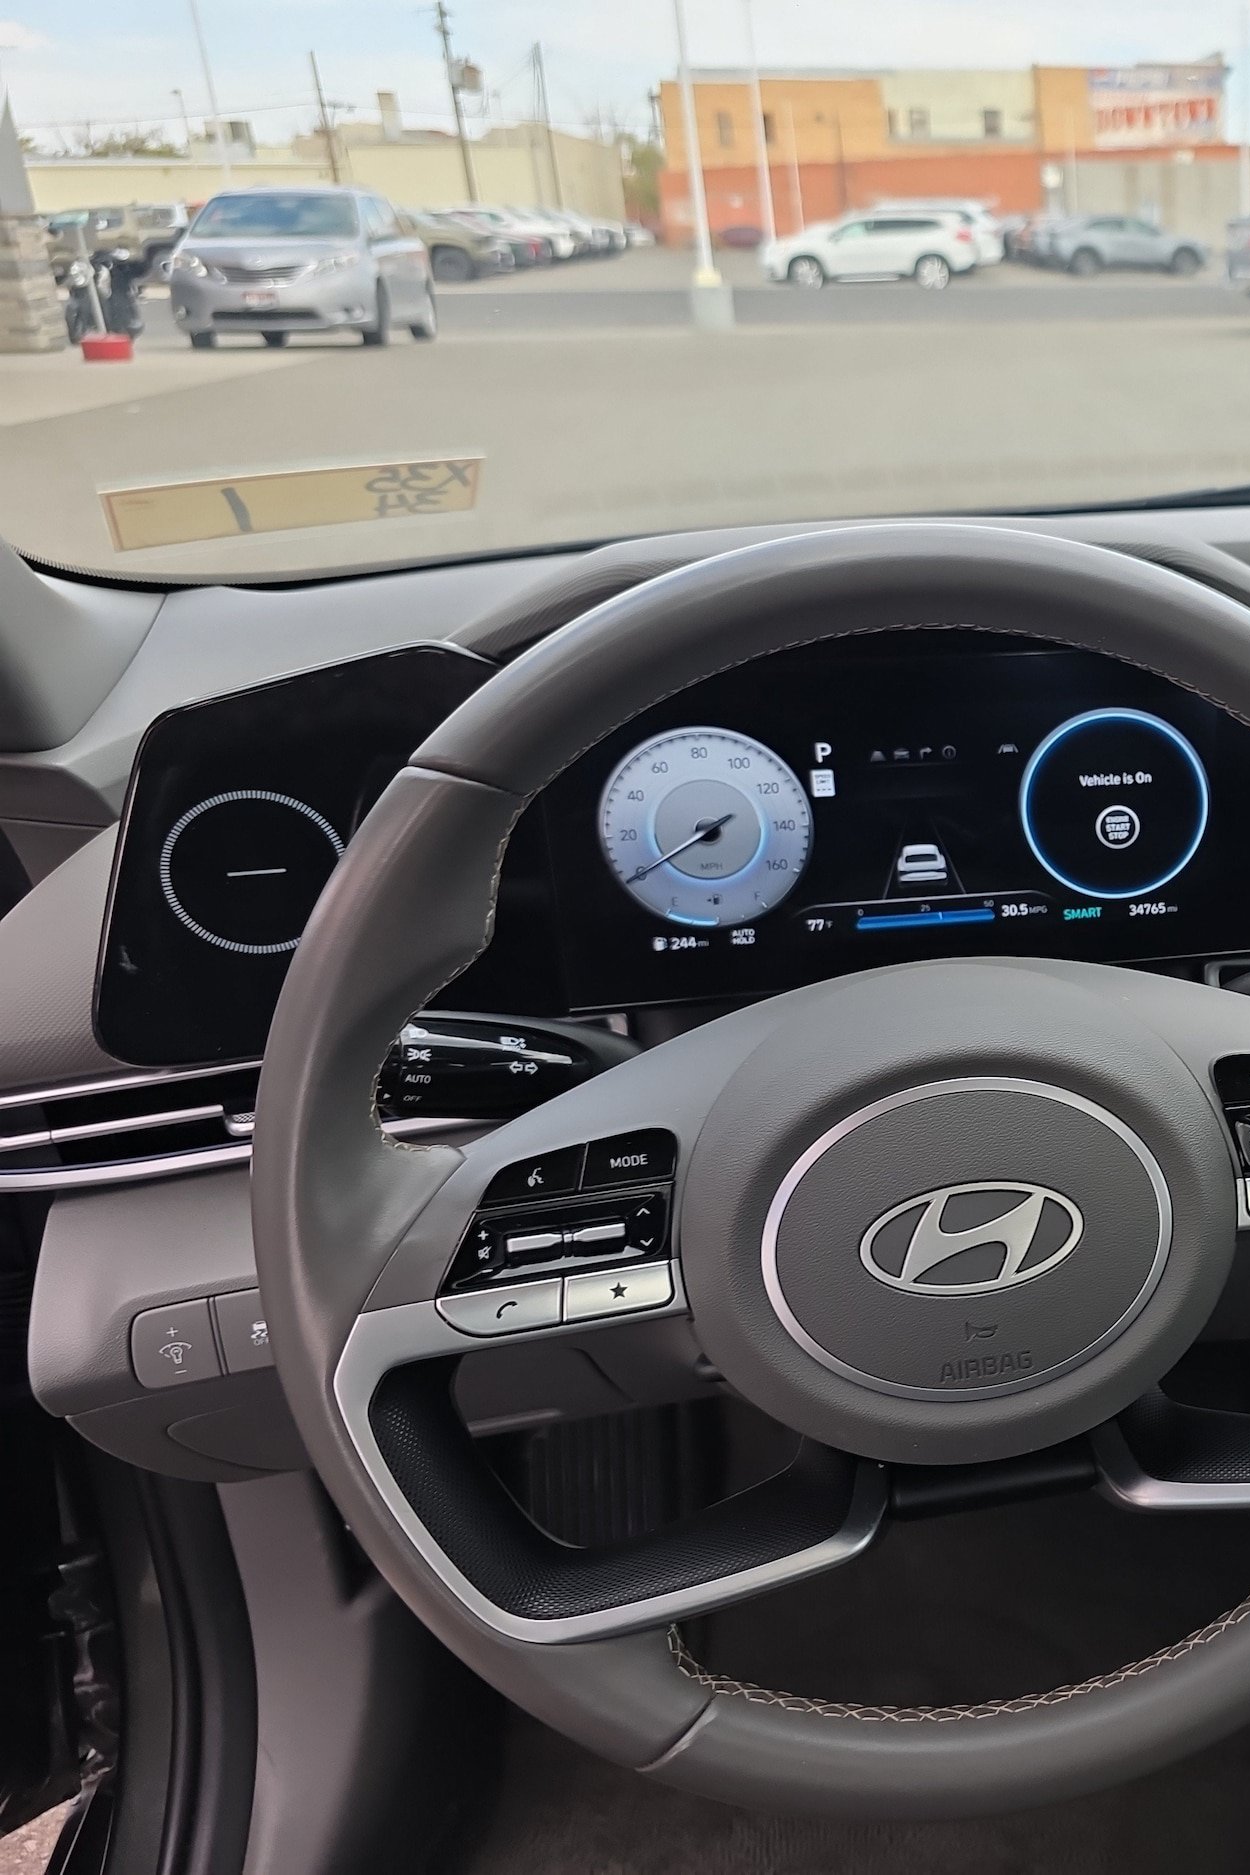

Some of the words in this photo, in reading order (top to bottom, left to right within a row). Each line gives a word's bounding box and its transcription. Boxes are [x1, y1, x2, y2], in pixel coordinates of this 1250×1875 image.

[690, 746, 708, 759] 80
[814, 741, 832, 763] P
[651, 760, 668, 774] 60
[727, 756, 751, 770] 100
[1079, 773, 1121, 787] Vehicle
[1122, 772, 1134, 785] is
[1135, 771, 1153, 784] On
[757, 781, 780, 795] 120
[627, 788, 645, 802] 40
[773, 818, 797, 832] 140
[1105, 823, 1131, 832] START
[620, 828, 638, 842] 20
[1108, 831, 1129, 841] STOP
[700, 861, 724, 872] MPH
[765, 858, 789, 872] 160
[671, 897, 679, 907] E
[754, 891, 762, 901] F
[920, 904, 932, 912] 25
[983, 899, 995, 908] 50
[1128, 902, 1167, 916] 34765
[1167, 904, 1178, 913] mi
[857, 908, 864, 916] 0
[1002, 904, 1029, 917] 30.5
[1029, 905, 1048, 914] MPG
[1063, 906, 1102, 921] SMART
[807, 919, 825, 932] 77
[731, 928, 756, 938] AUTO
[672, 936, 698, 949] 244
[698, 939, 710, 948] mi
[731, 936, 756, 946] HOLD
[405, 1073, 432, 1085] AUTO
[403, 1094, 423, 1103] OFF
[609, 1153, 649, 1170] MODE
[940, 1351, 1034, 1385] AIRBAG
